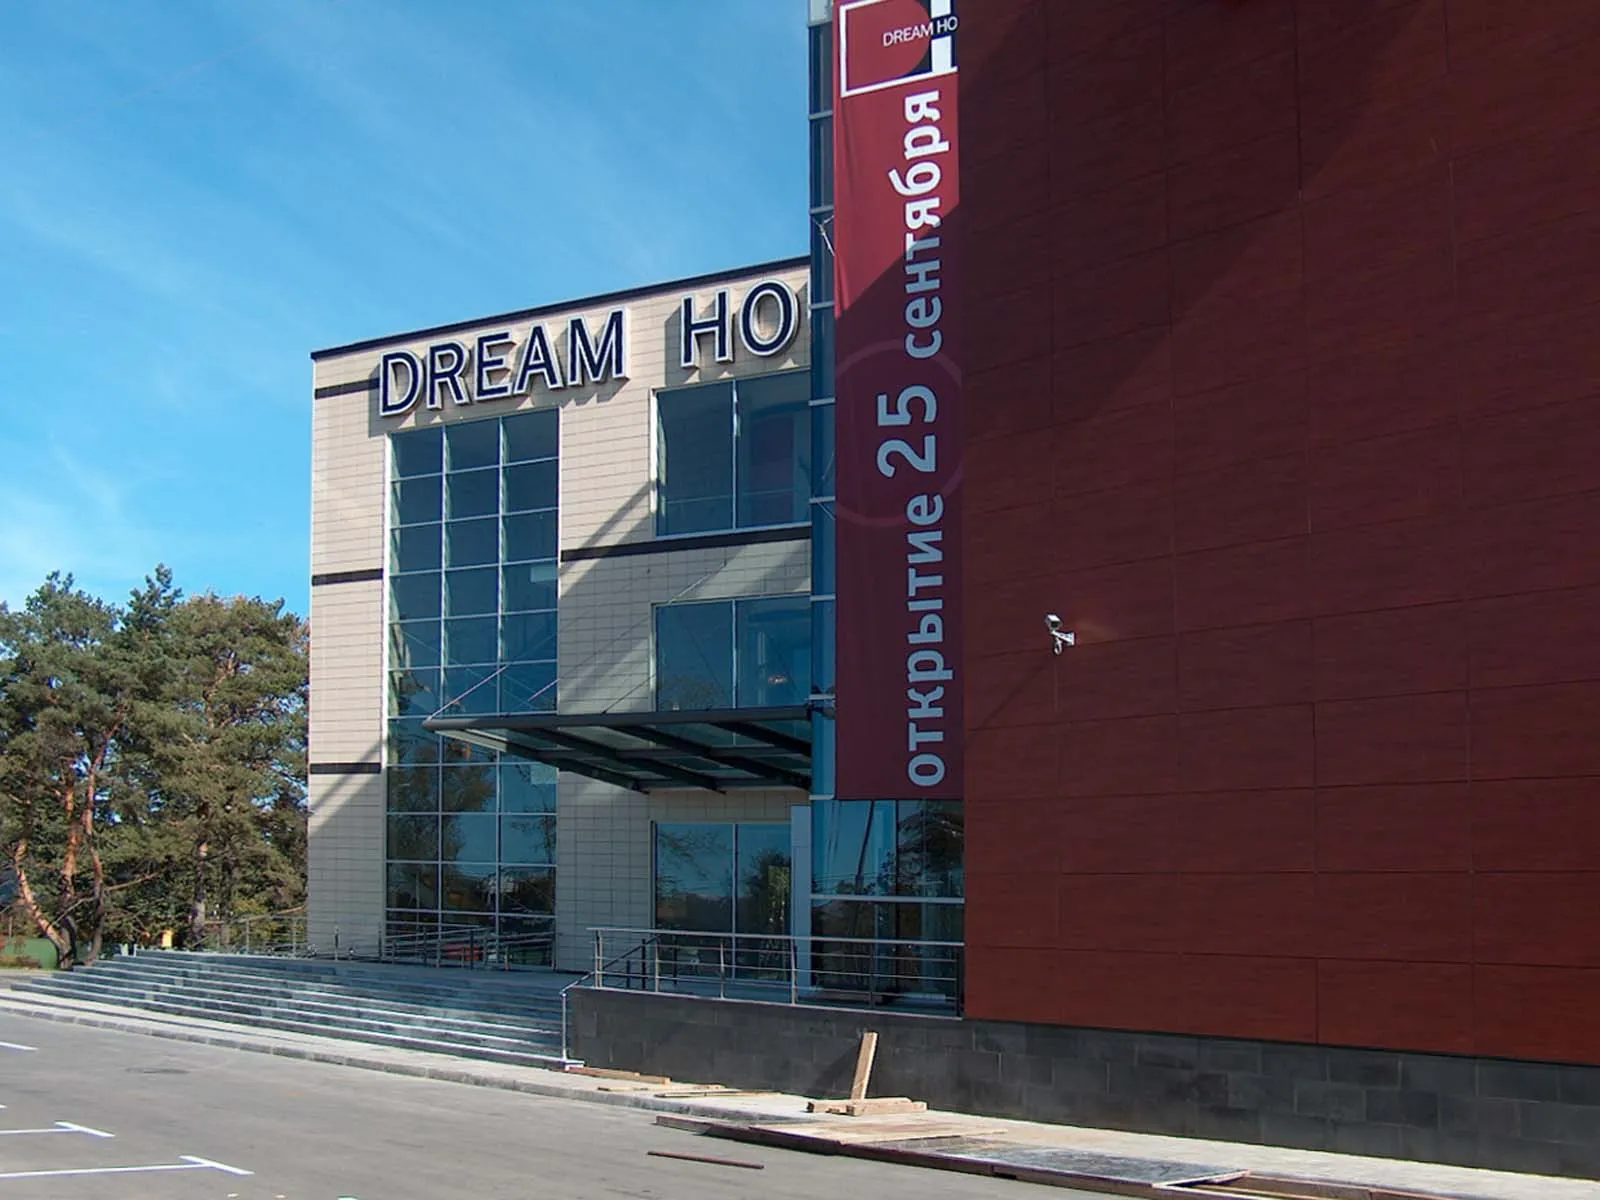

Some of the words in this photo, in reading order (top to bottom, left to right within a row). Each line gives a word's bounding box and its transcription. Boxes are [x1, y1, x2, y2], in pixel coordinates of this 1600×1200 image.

[883, 22, 934, 47] DREAM
[936, 16, 958, 34] HO
[888, 90, 949, 359] сентября
[378, 307, 630, 417] DREAM
[680, 279, 799, 368] HO
[876, 384, 938, 478] 25
[907, 494, 953, 787] открытие
